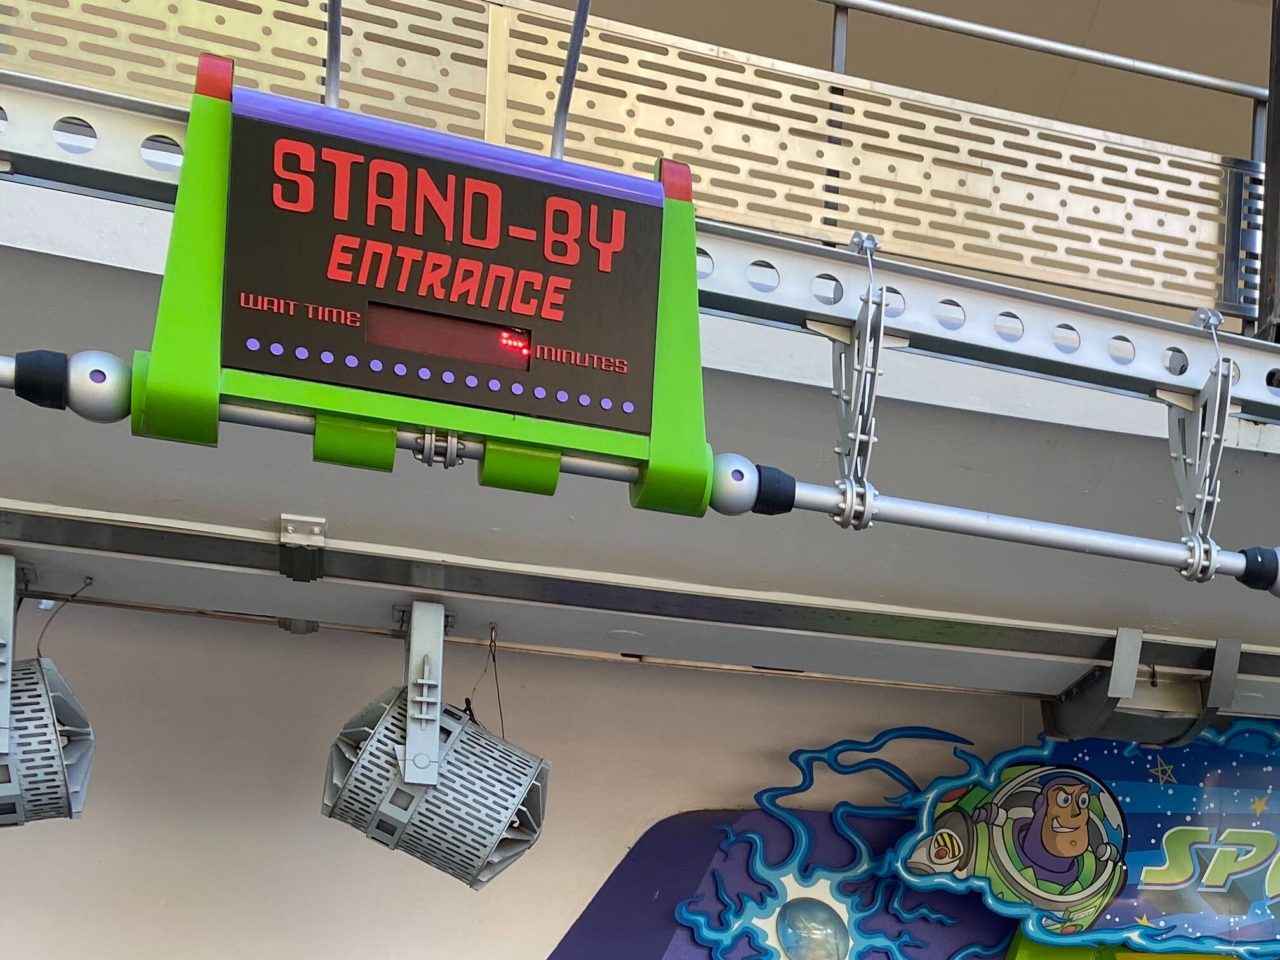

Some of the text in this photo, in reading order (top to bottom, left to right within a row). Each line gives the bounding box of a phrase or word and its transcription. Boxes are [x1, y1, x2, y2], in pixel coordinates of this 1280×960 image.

[272, 138, 626, 274] STAND-BY
[327, 234, 571, 322] ENTRANCE
[240, 292, 361, 328] WAIT TIME
[536, 344, 628, 374] MINUTES
